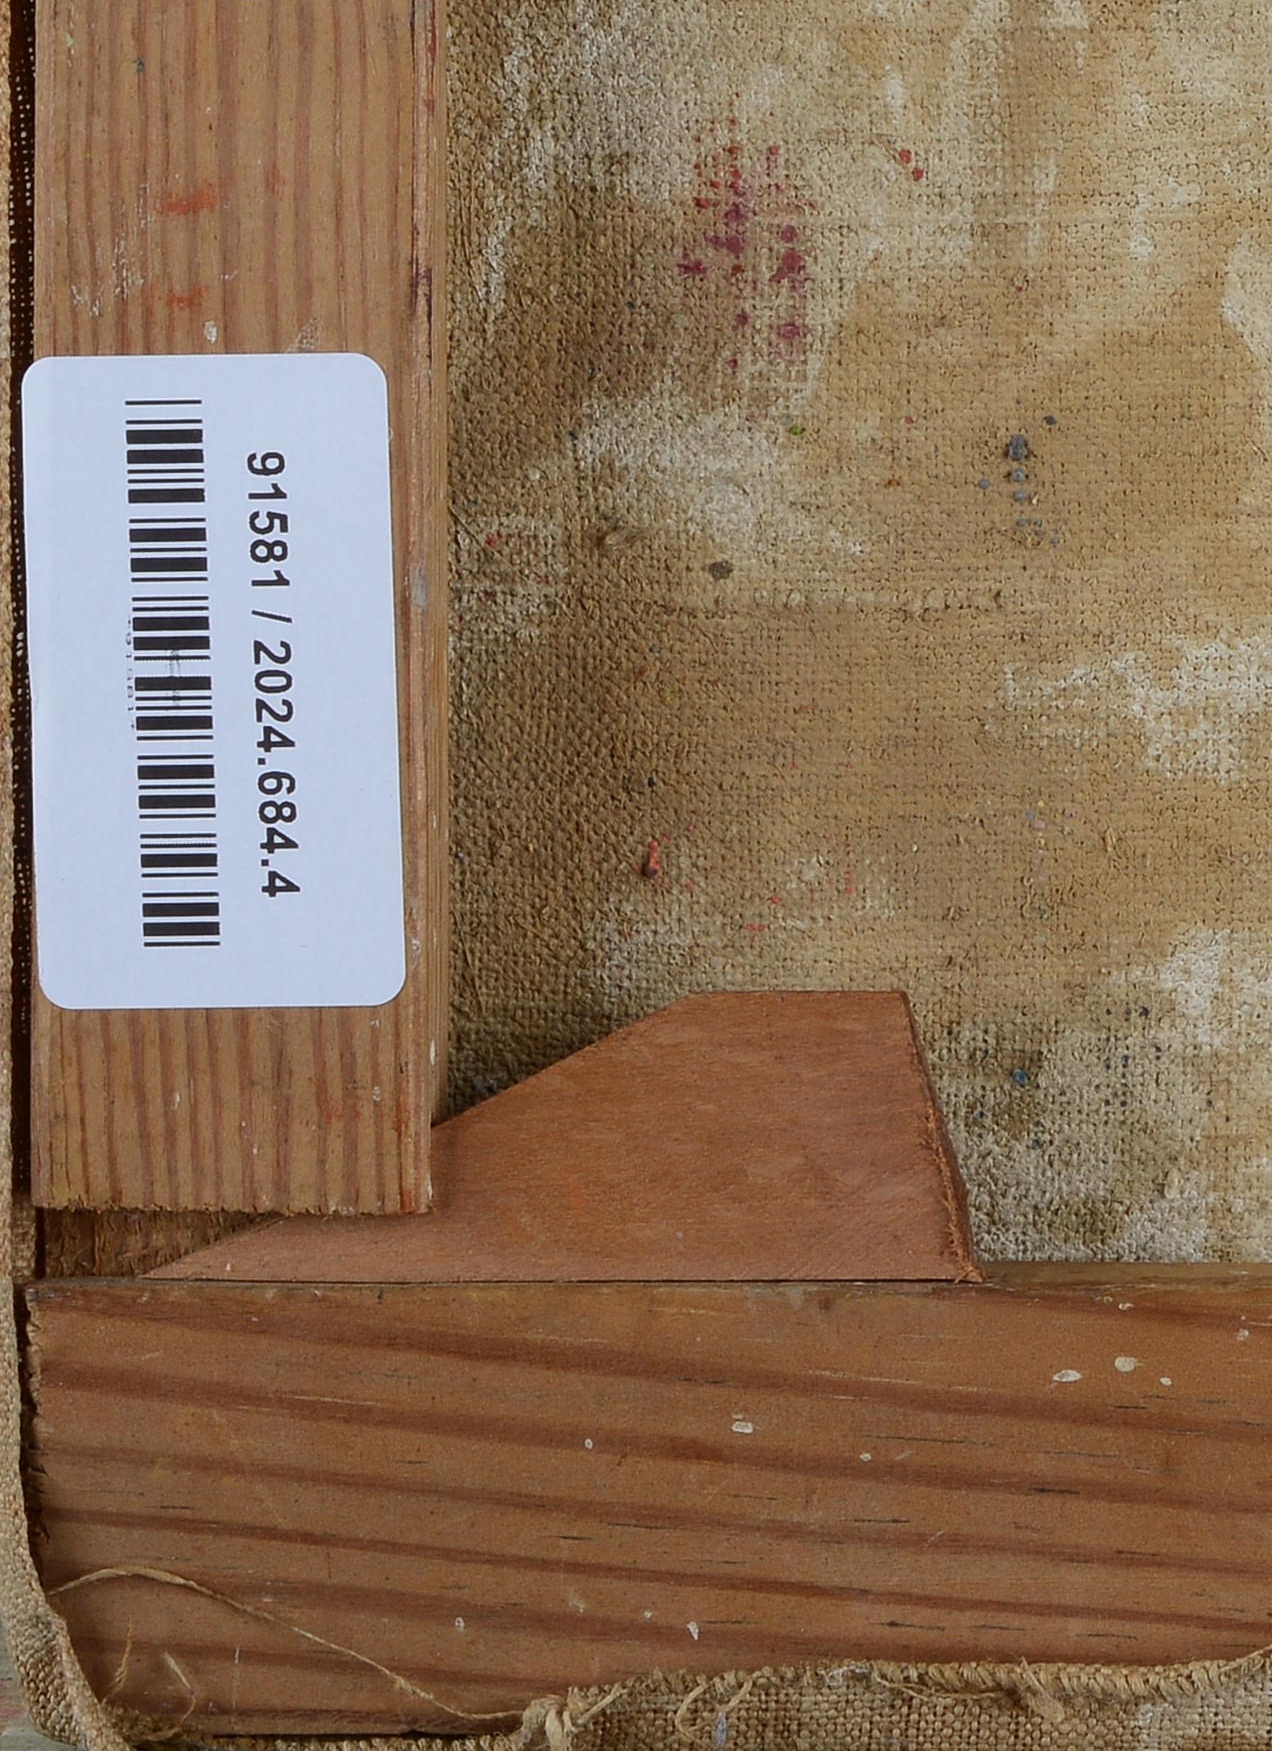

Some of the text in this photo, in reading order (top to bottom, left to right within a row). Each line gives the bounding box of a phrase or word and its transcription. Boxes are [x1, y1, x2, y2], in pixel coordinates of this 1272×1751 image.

[246, 451, 301, 898] 91581 / 2024.684.4
